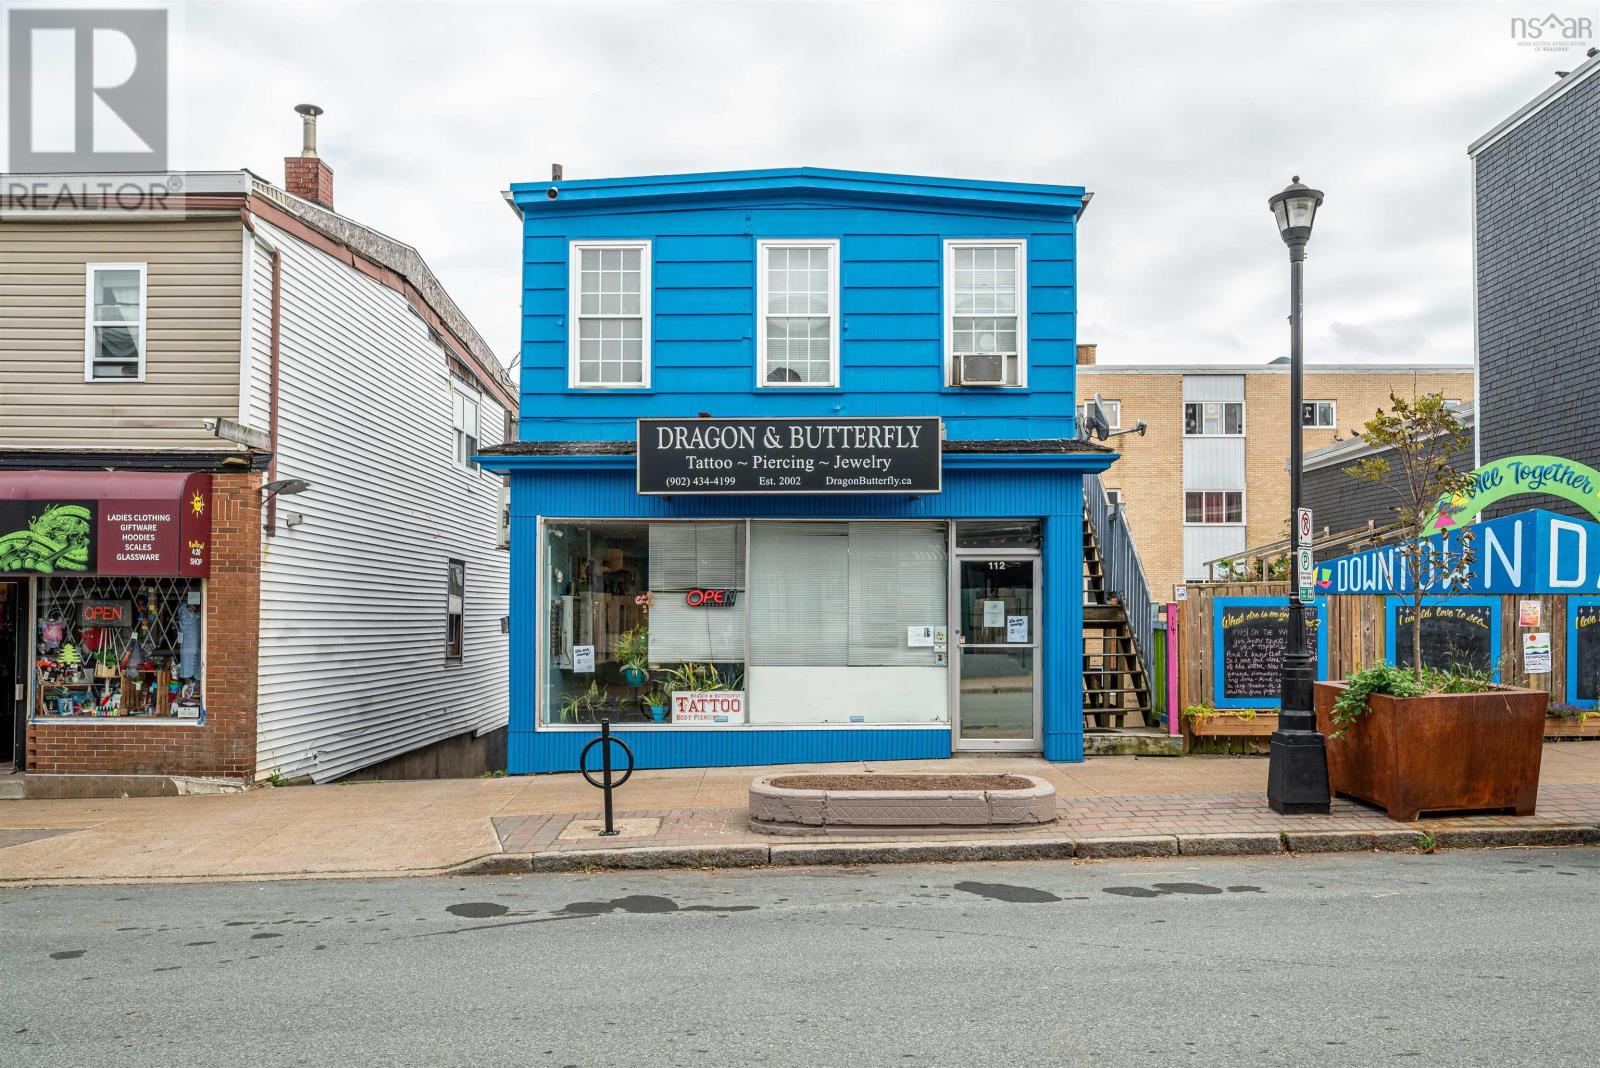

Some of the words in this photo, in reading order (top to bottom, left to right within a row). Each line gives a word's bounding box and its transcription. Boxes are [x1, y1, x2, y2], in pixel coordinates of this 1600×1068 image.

[656, 425, 755, 450] DRAGON
[762, 426, 783, 450] &
[789, 425, 922, 449] BUTTERFLY
[686, 455, 733, 470] Tattoo
[752, 455, 814, 472] Piercing
[834, 455, 892, 472] Jewelry
[666, 476, 691, 487] (902)
[692, 476, 736, 486] 434-4199
[758, 476, 776, 486] Est.
[779, 476, 801, 486] 2002
[825, 476, 912, 487] DragonButterfly.ca
[1507, 461, 1594, 495] Together
[133, 514, 171, 522] CLOTHING
[190, 558, 203, 566] SHOP
[988, 562, 1006, 570] 112
[686, 588, 737, 606] OPEN
[84, 606, 123, 620] OPEN
[1436, 607, 1453, 617] love
[675, 696, 742, 713] TATTOO
